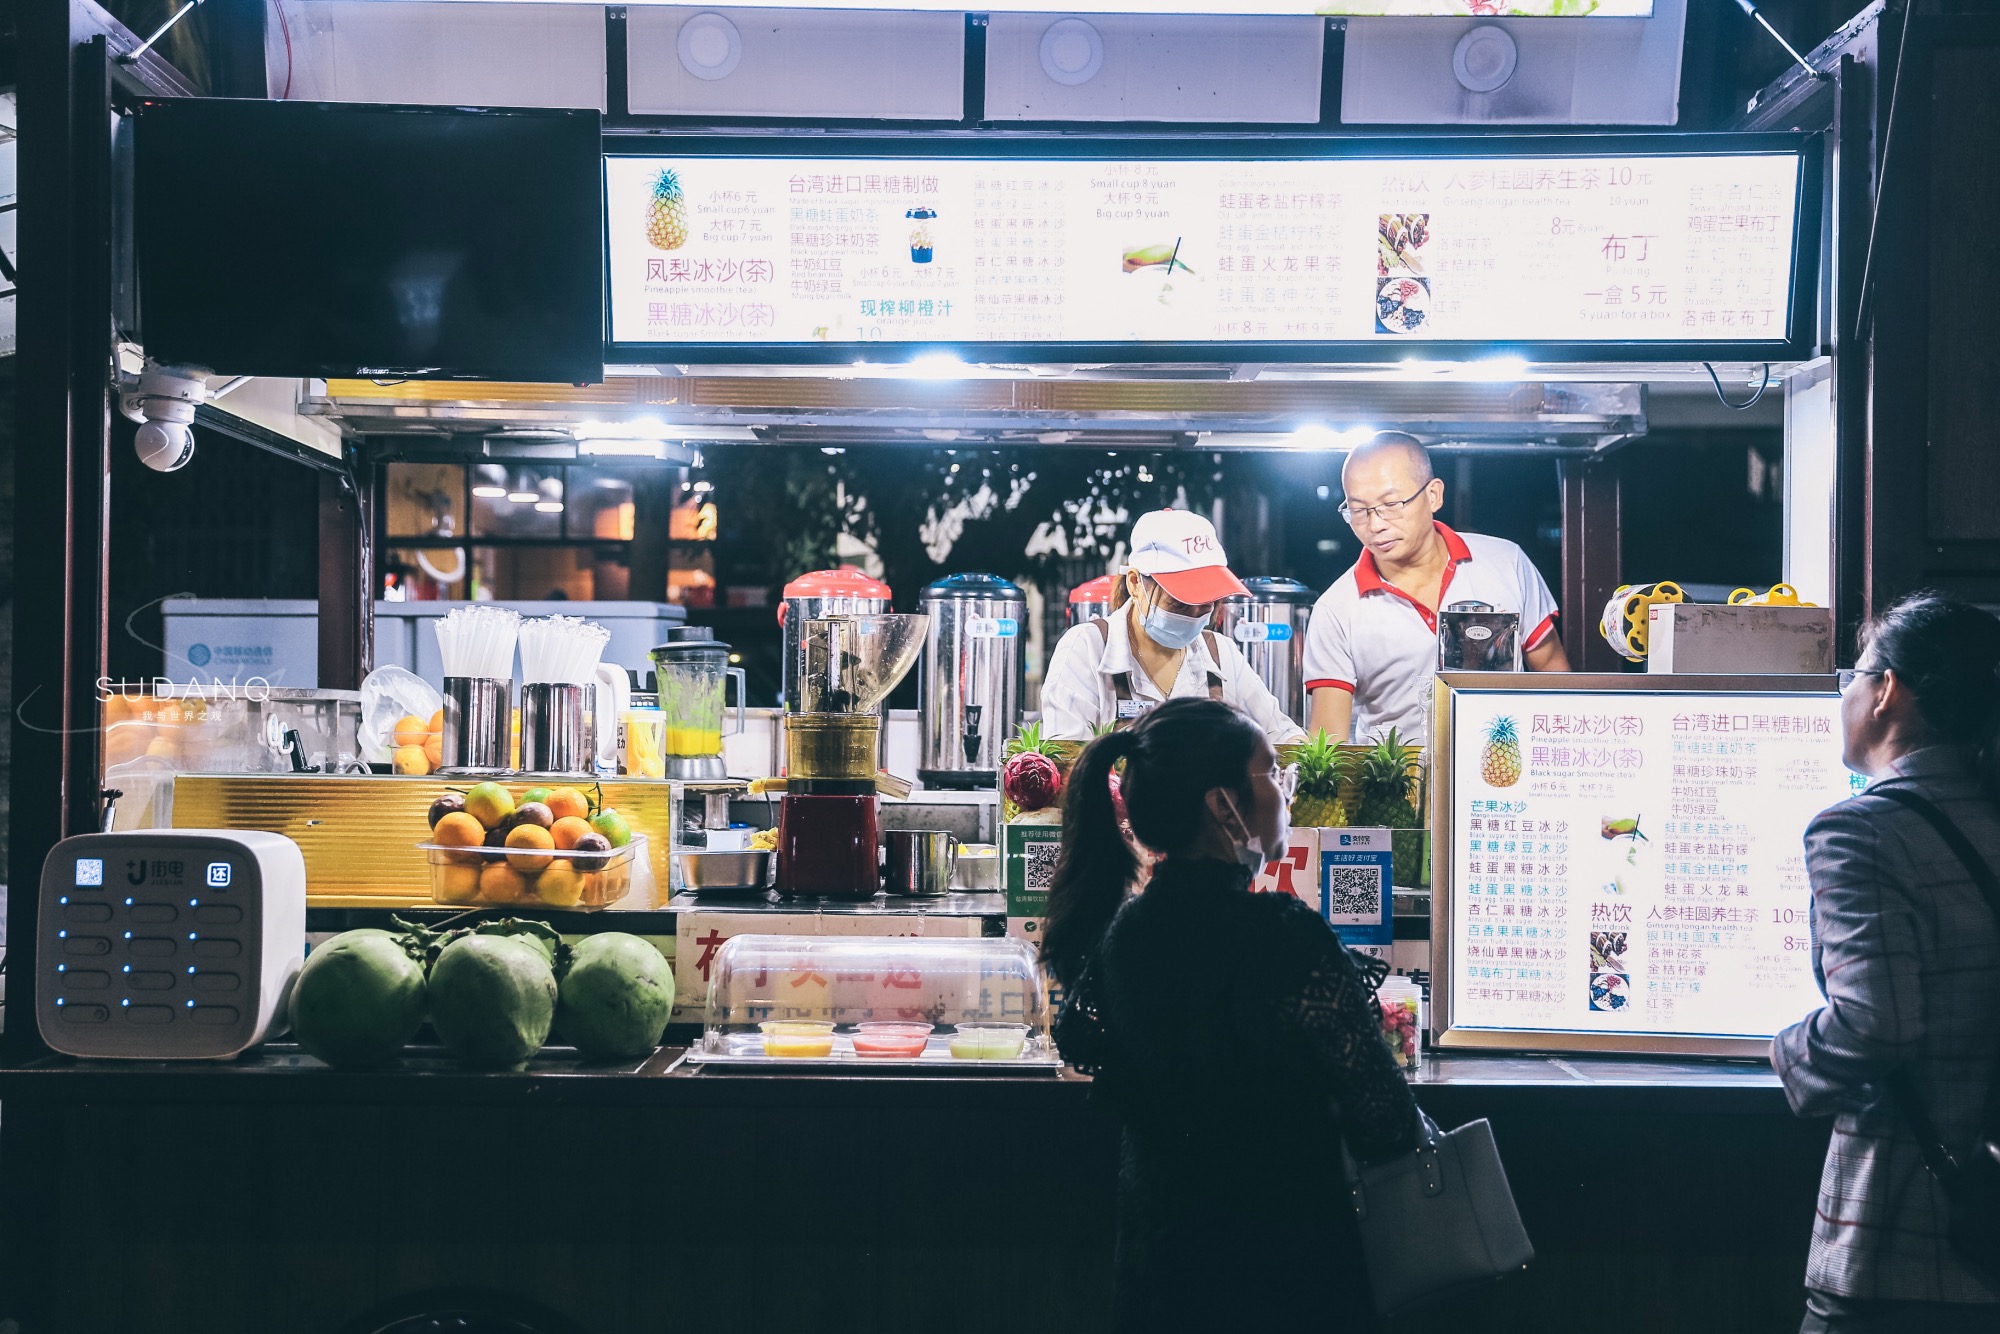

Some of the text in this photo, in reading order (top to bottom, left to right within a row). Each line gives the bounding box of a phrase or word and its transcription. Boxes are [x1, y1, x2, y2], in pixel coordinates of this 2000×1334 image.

[789, 174, 939, 194] 台湾进口黑糖制做
[1090, 179, 1176, 190] Small cup 8 yuan
[1444, 167, 1600, 191] 人参桂圆养生茶
[1218, 193, 1342, 210] 蛙蛋老盐柠檬茶
[697, 205, 723, 215] Small
[752, 205, 775, 215] yuan
[790, 207, 879, 223] 黑糖蛙蛋奶茶
[1096, 209, 1170, 220] Big cup 9 yuan
[703, 233, 773, 243] Big cup 7 yuan
[790, 232, 880, 248] 黑糖珍珠奶茶
[1601, 233, 1659, 262] 布丁
[646, 258, 774, 284] 凤梨冰沙(茶)
[790, 258, 842, 271] 牛奶红豆
[1218, 256, 1342, 272] 蛙蛋火龙果茶
[790, 280, 843, 294] 牛奶绿豆
[647, 302, 775, 327] 黑糖冰沙(茶)
[860, 299, 954, 317] 现榨柳橙汁
[1590, 309, 1617, 321] yuan
[1620, 309, 1636, 321] for
[1640, 309, 1646, 321] a
[1650, 309, 1671, 321] box
[1682, 308, 1775, 326] 洛神花布丁
[1531, 714, 1644, 736] 凤梨冰沙(茶)
[1672, 713, 1831, 735] 台湾进口黑糖制做
[1530, 746, 1644, 770] 黑糖冰沙(茶)
[1530, 770, 1550, 779] Black
[1552, 770, 1574, 779] sugar
[1576, 770, 1614, 779] Smoothie
[1672, 765, 1758, 779] 黑糖珍珠奶茶
[1671, 786, 1717, 798] 牛奶红豆
[1470, 800, 1528, 814] 芒果冰沙
[1671, 804, 1717, 815] 牛奶绿豆
[1470, 818, 1568, 832] 黑糖红豆冰沙
[1470, 840, 1568, 854] 黑糖绿豆冰沙
[1664, 842, 1748, 856] 蛙蛋老盐柠檬
[212, 867, 227, 882] 还
[1468, 862, 1568, 876] 蛙蛋黑糖冰沙
[1664, 862, 1749, 876] 蛙蛋金桔柠檬
[1468, 884, 1568, 898] 蛙蛋黑糖冰沙
[1664, 883, 1749, 897] 蛙蛋火龙果
[1468, 904, 1568, 918] 杏仁黑糖冰沙
[1591, 902, 1632, 923] 热饮
[1646, 904, 1759, 922] 人参桂圆养生茶
[1468, 924, 1568, 939] 百香果黑糖冰沙
[1784, 936, 1809, 952] 8元
[1467, 946, 1566, 960] 烧仙草黑糖冰沙
[1648, 948, 1702, 960] 洛神花茶
[1467, 966, 1566, 982] 草莓布丁黑糖冰沙
[1647, 964, 1706, 976] 金桔柠檬
[1466, 988, 1566, 1004] 芒果布丁黑糖冰沙
[1646, 998, 1674, 1010] 红茶
